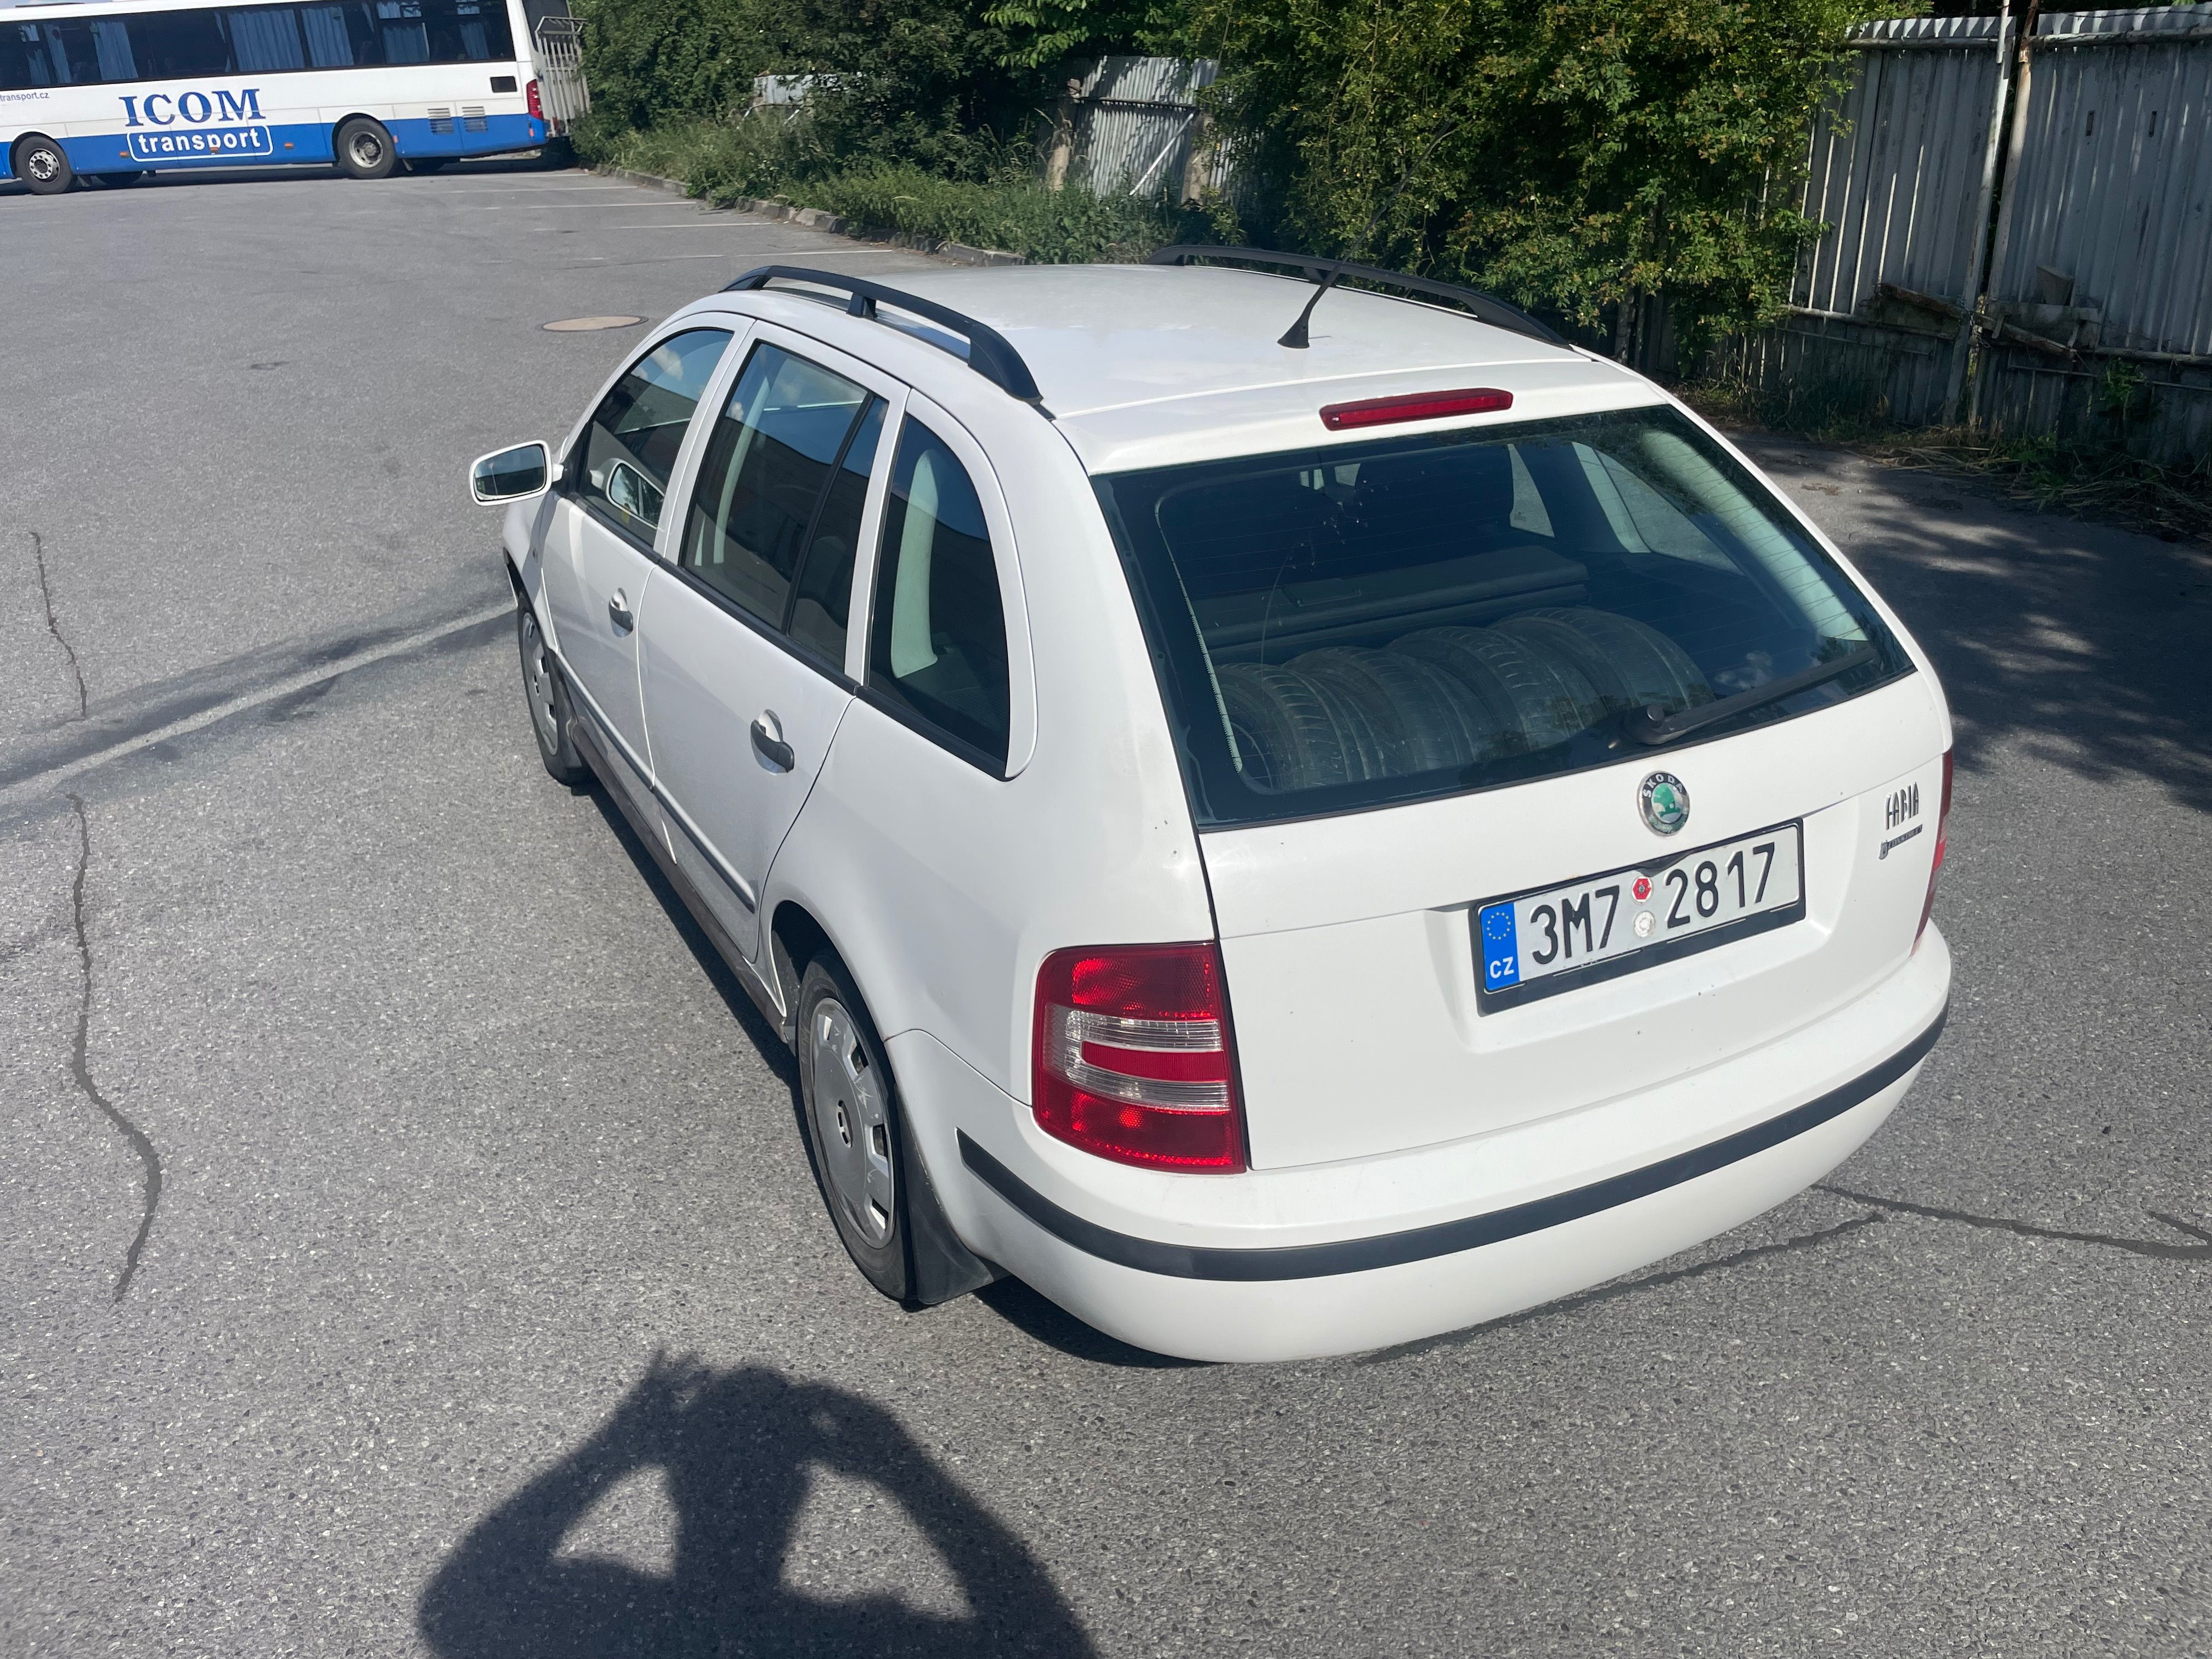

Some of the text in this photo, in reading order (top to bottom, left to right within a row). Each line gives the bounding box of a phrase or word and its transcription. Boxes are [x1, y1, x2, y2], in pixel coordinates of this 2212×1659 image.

[118, 88, 267, 127] ICOM
[138, 128, 261, 154] transport
[1884, 781, 1919, 831] FABIA
[1530, 842, 1775, 965] 3M7 2817
[1489, 956, 1515, 979] CZ
